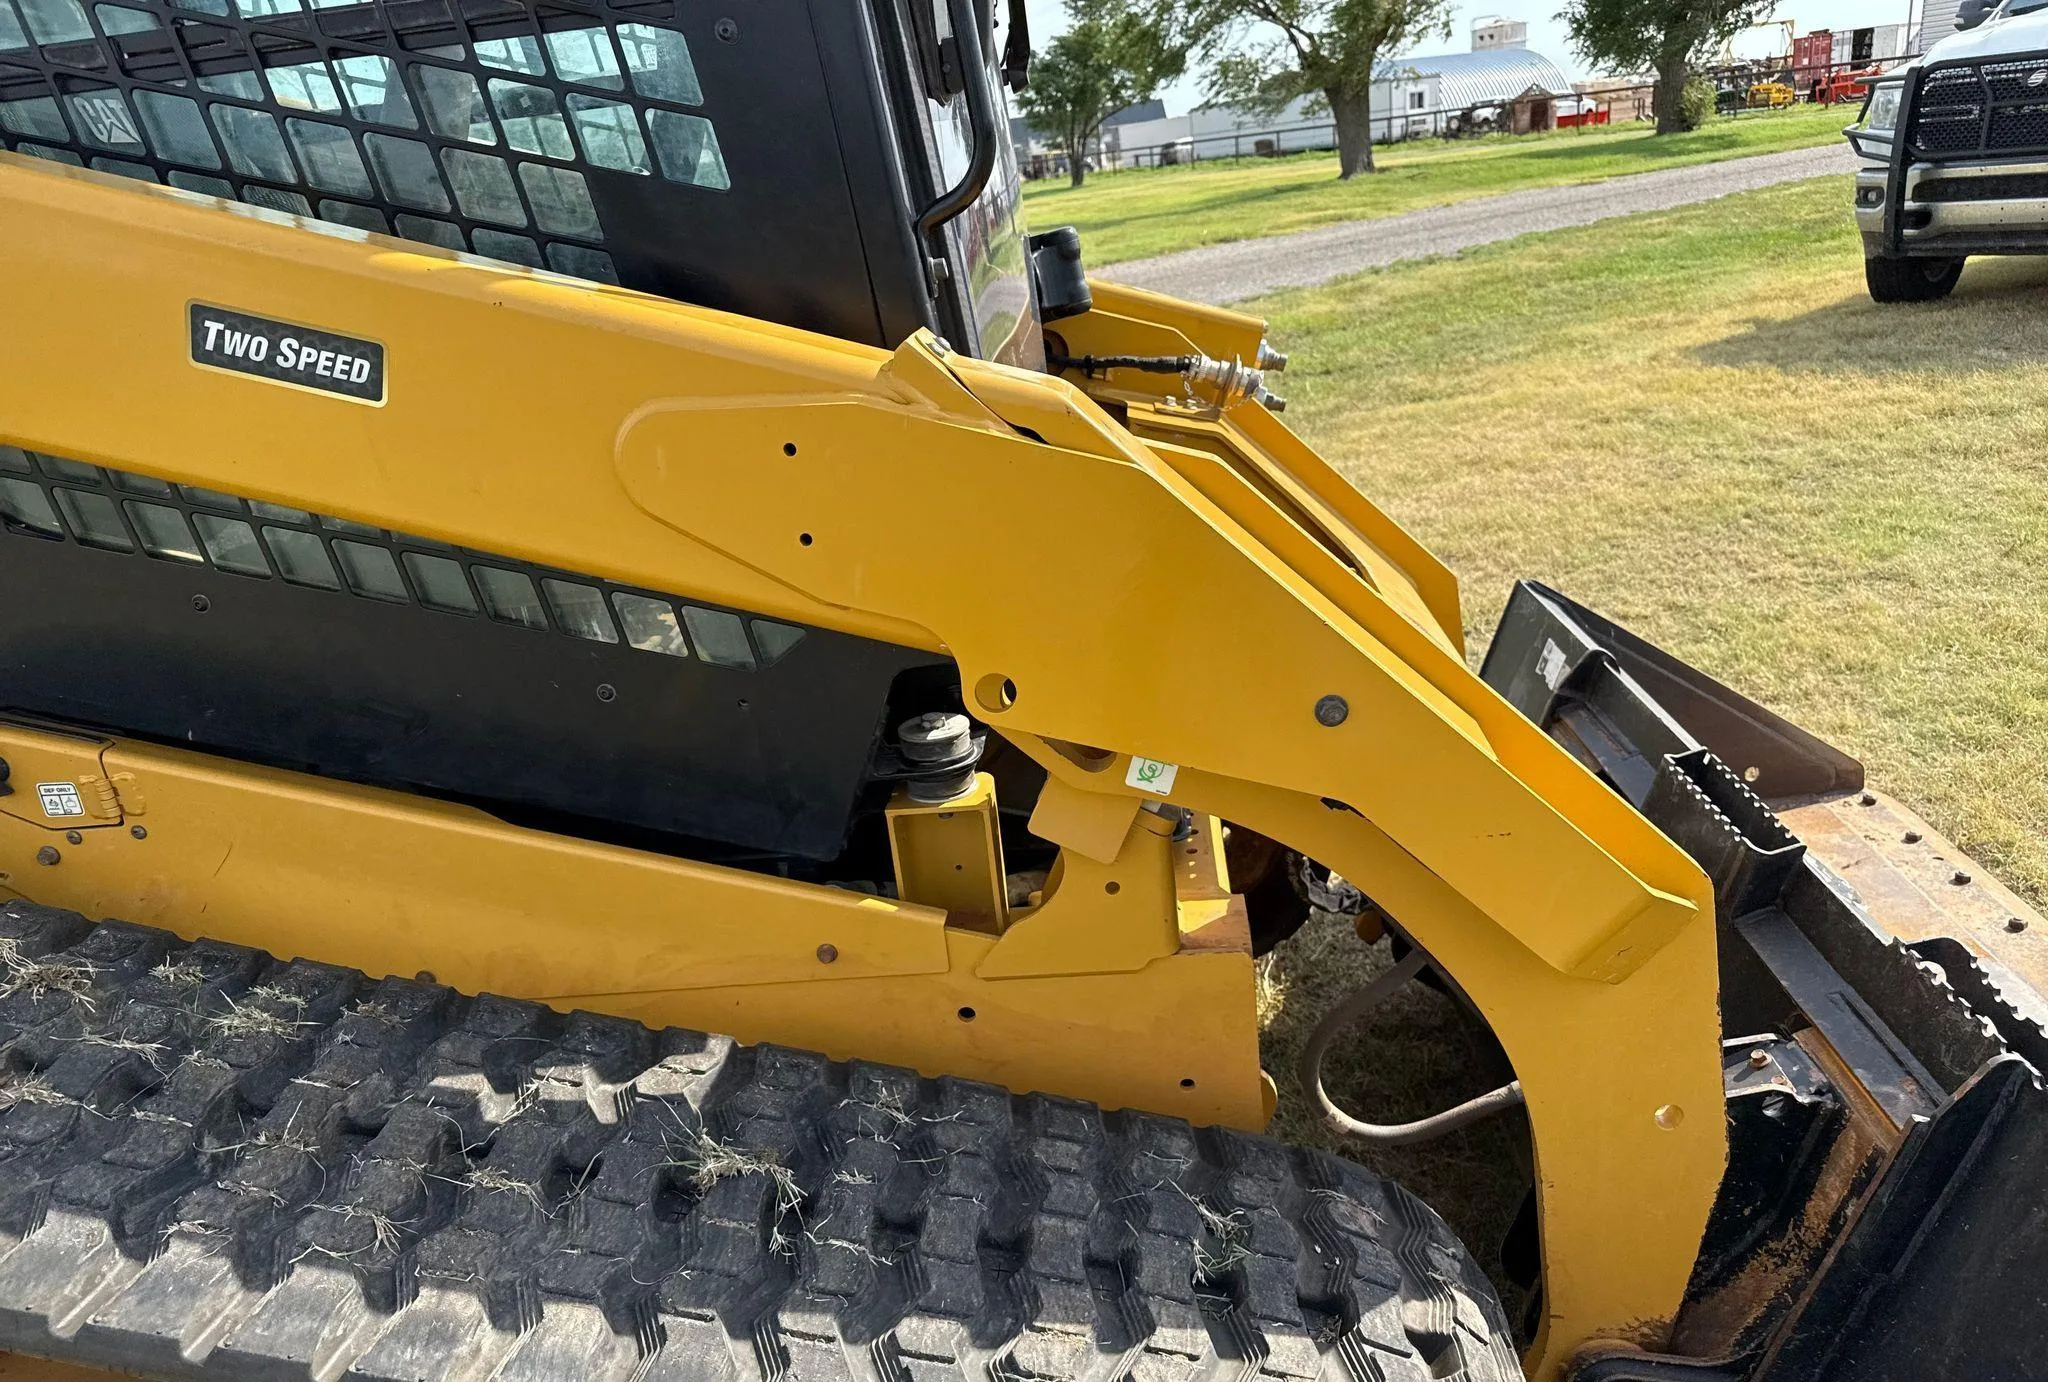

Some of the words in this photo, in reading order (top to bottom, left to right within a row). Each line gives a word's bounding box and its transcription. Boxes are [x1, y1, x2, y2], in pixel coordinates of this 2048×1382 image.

[75, 97, 141, 143] CAT
[203, 320, 269, 362] TWO
[276, 337, 371, 384] SPEED
